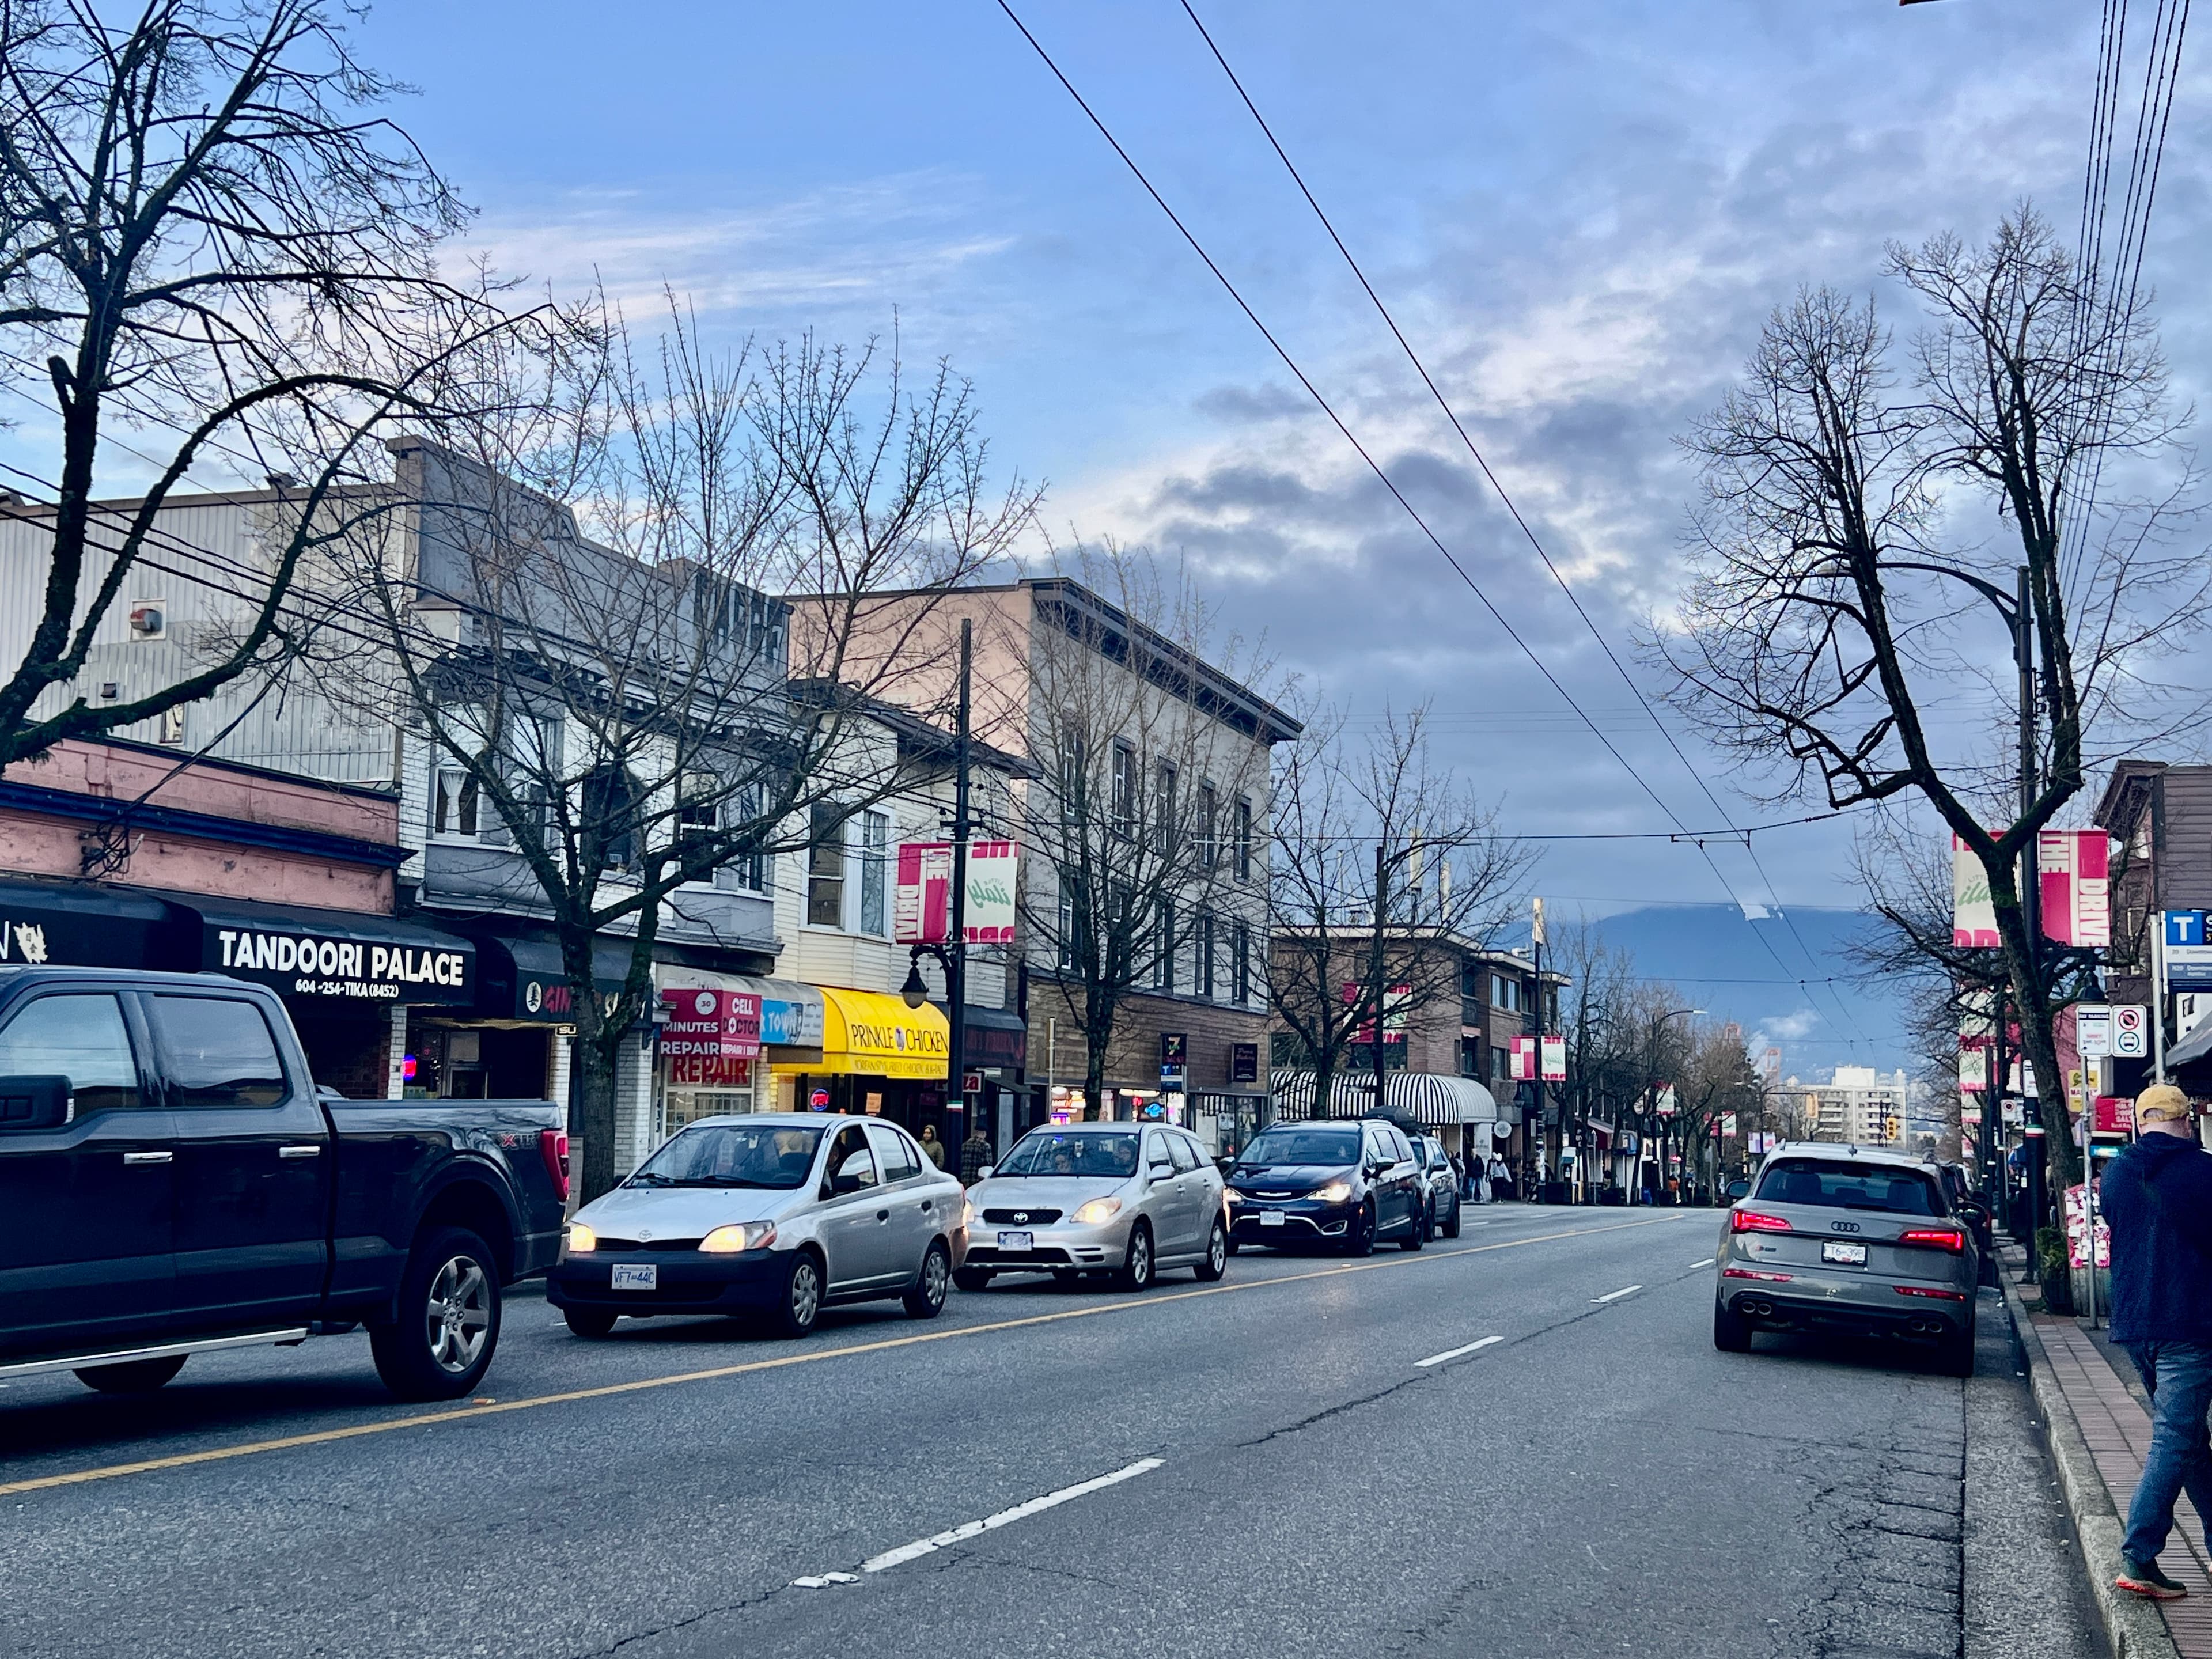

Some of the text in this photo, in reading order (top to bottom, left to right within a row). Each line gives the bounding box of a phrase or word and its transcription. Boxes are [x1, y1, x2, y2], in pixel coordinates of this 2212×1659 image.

[2173, 916, 2194, 941] T
[219, 931, 463, 986] TANDOORI PALACE
[732, 997, 754, 1016] CELL
[662, 1022, 719, 1033] MINUTES
[851, 1024, 895, 1049] PRINKLE
[906, 1028, 949, 1052] CHICKEN
[660, 1041, 720, 1055] REPAIR
[721, 1043, 760, 1056] REPAIR BUY
[672, 1056, 748, 1084] REPAIR
